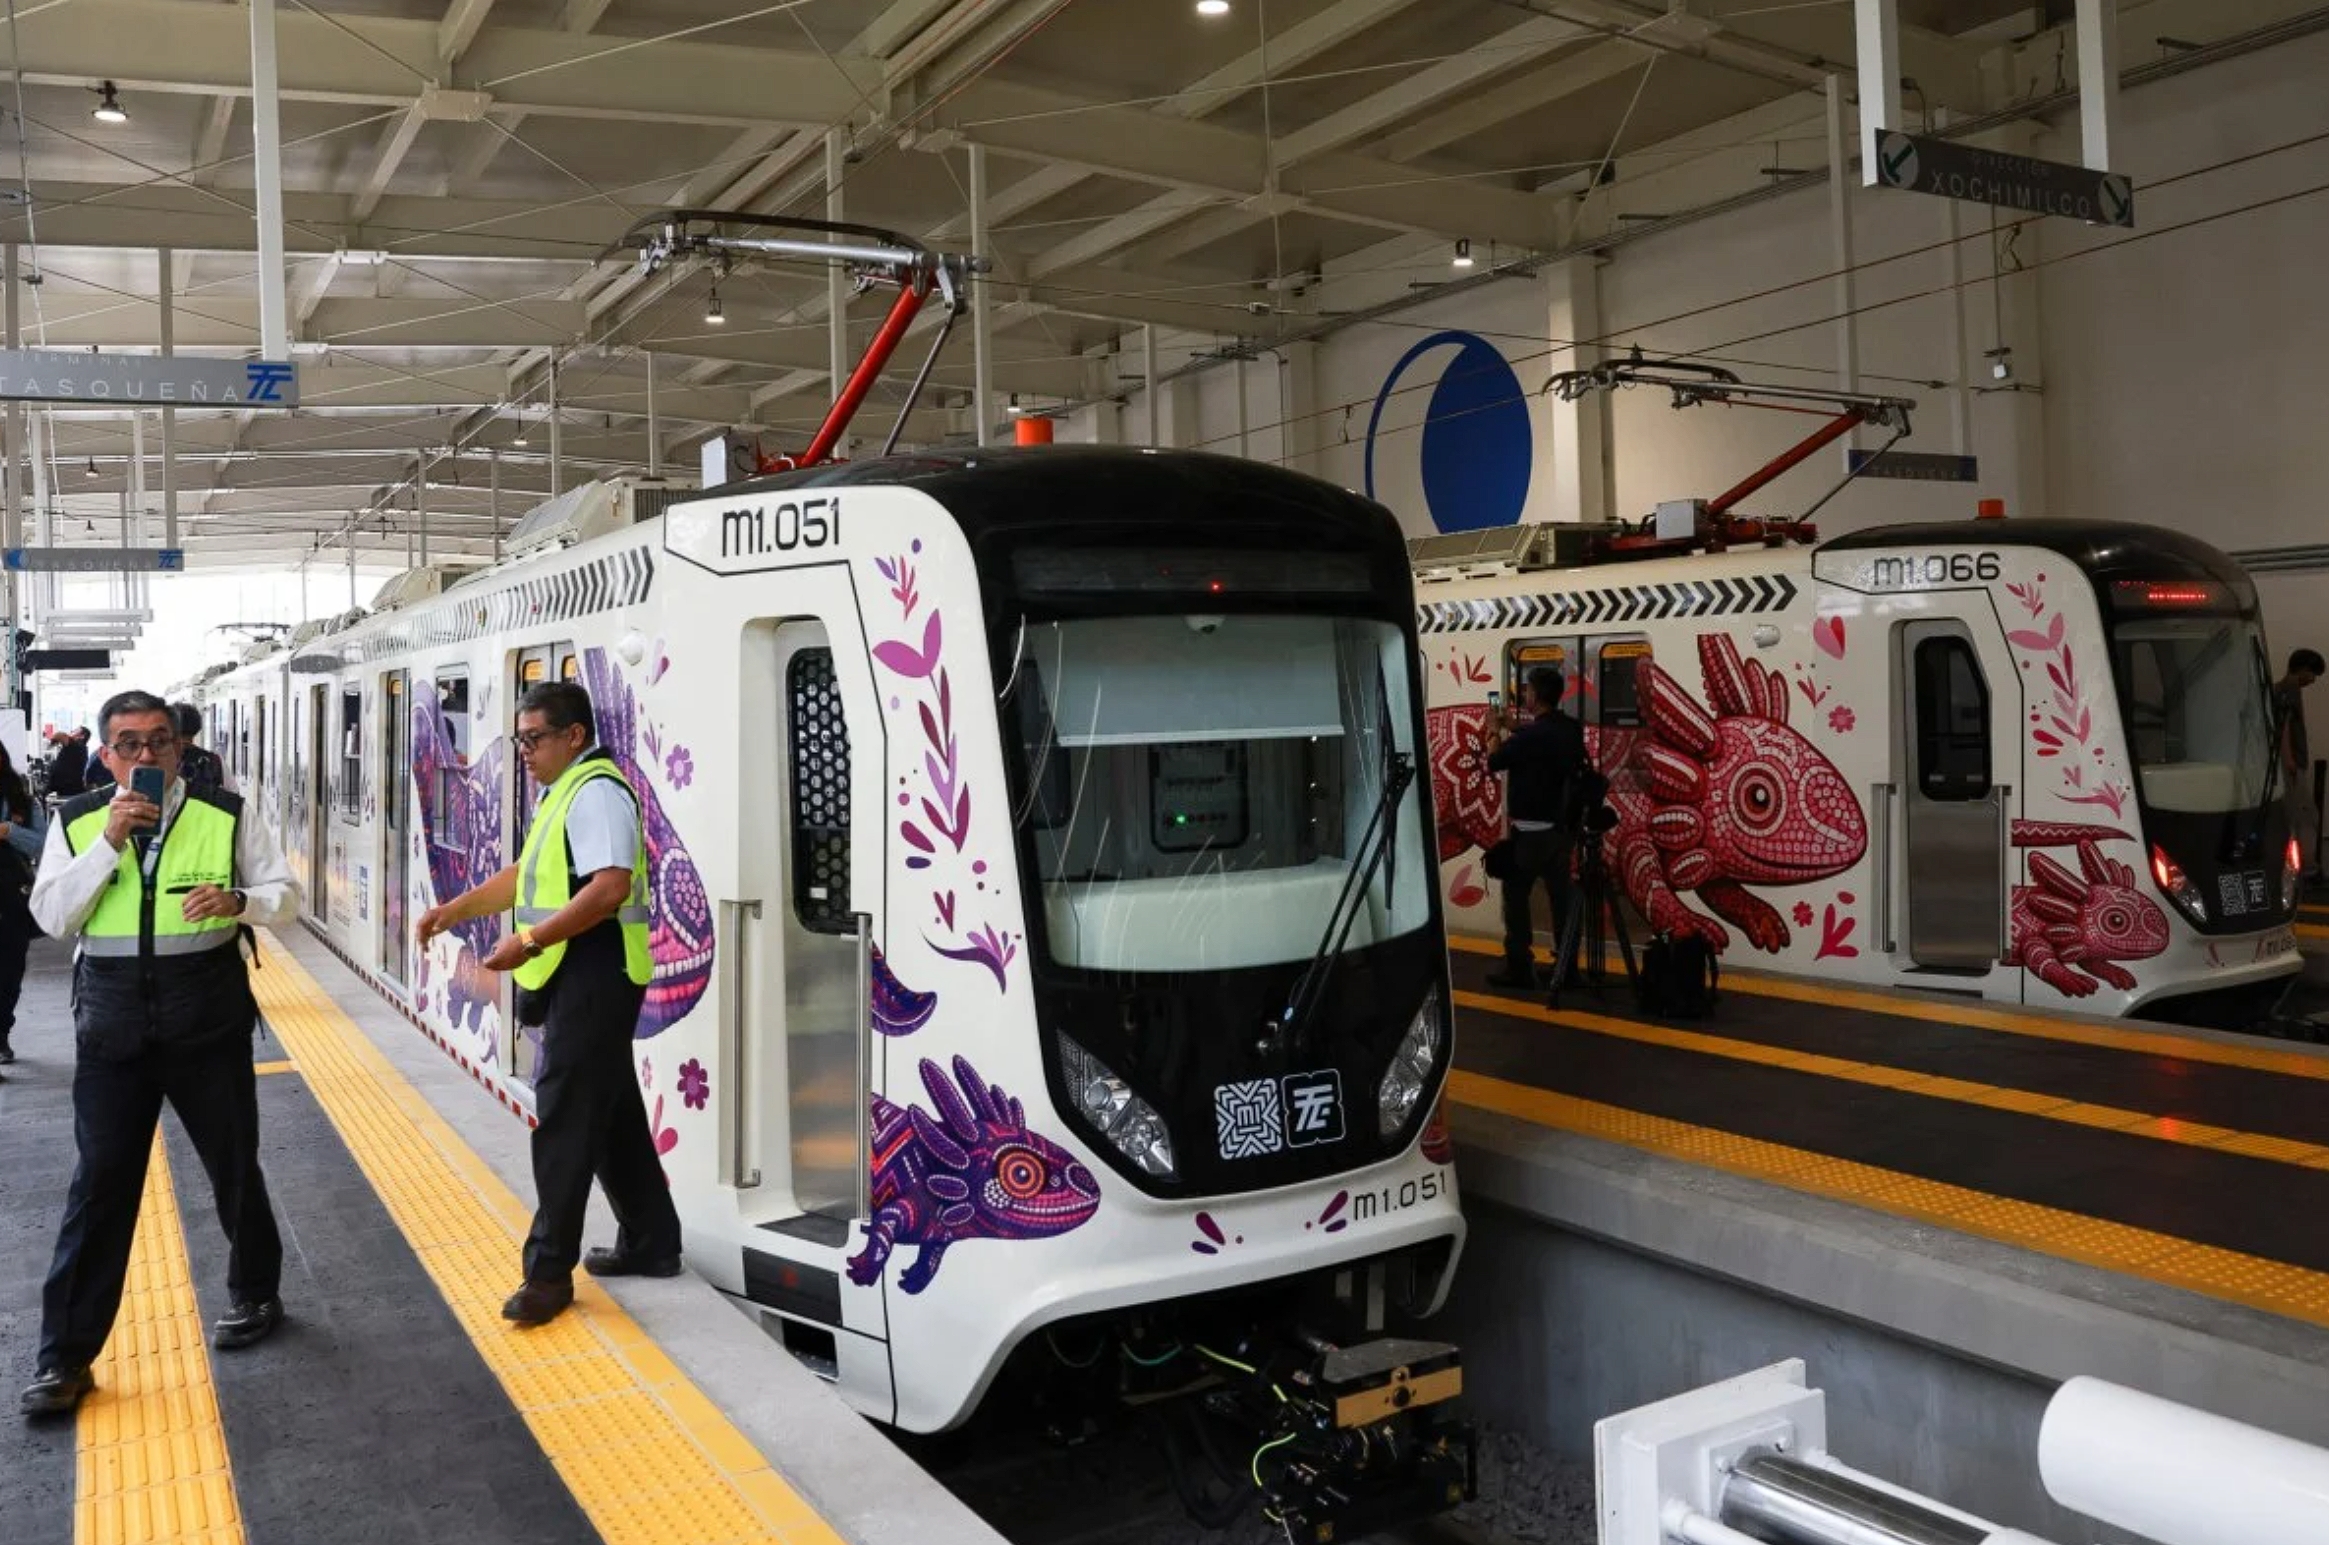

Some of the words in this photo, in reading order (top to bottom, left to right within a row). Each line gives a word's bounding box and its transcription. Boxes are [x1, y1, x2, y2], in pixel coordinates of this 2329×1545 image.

[1931, 170, 2092, 218] XOCHIMILCO
[722, 496, 840, 557] m1.051
[1874, 551, 2000, 586] m1.066
[1353, 1169, 1447, 1221] m1.051
